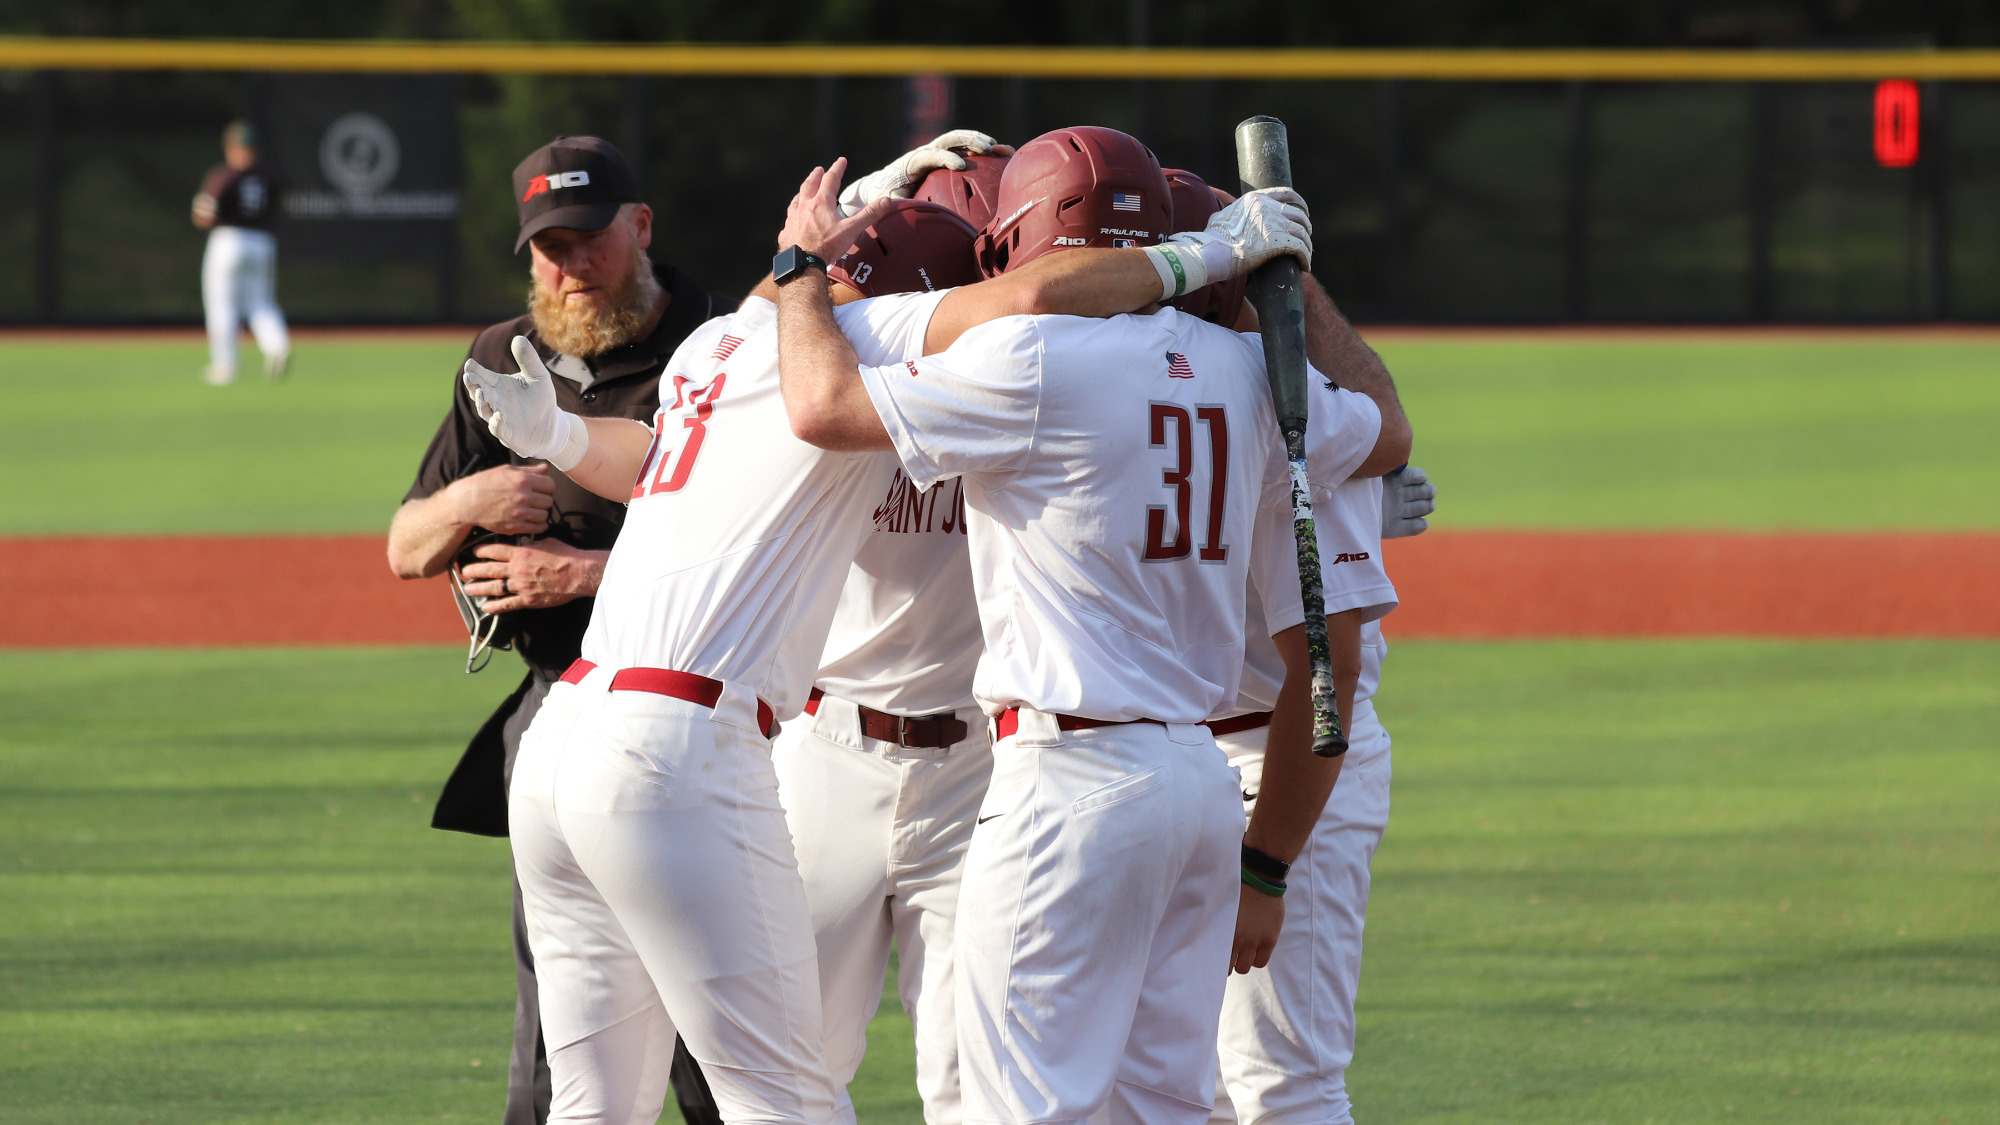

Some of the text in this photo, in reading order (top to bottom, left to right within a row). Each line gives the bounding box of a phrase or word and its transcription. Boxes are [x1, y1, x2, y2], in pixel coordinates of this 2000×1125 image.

[1873, 77, 1920, 167] 0
[523, 171, 590, 202] A10
[1051, 236, 1086, 246] A10
[1100, 227, 1149, 238] RAWLINGS
[851, 261, 873, 285] 13
[918, 267, 936, 292] RAW
[1141, 399, 1230, 565] 31
[1333, 552, 1370, 565] A10
